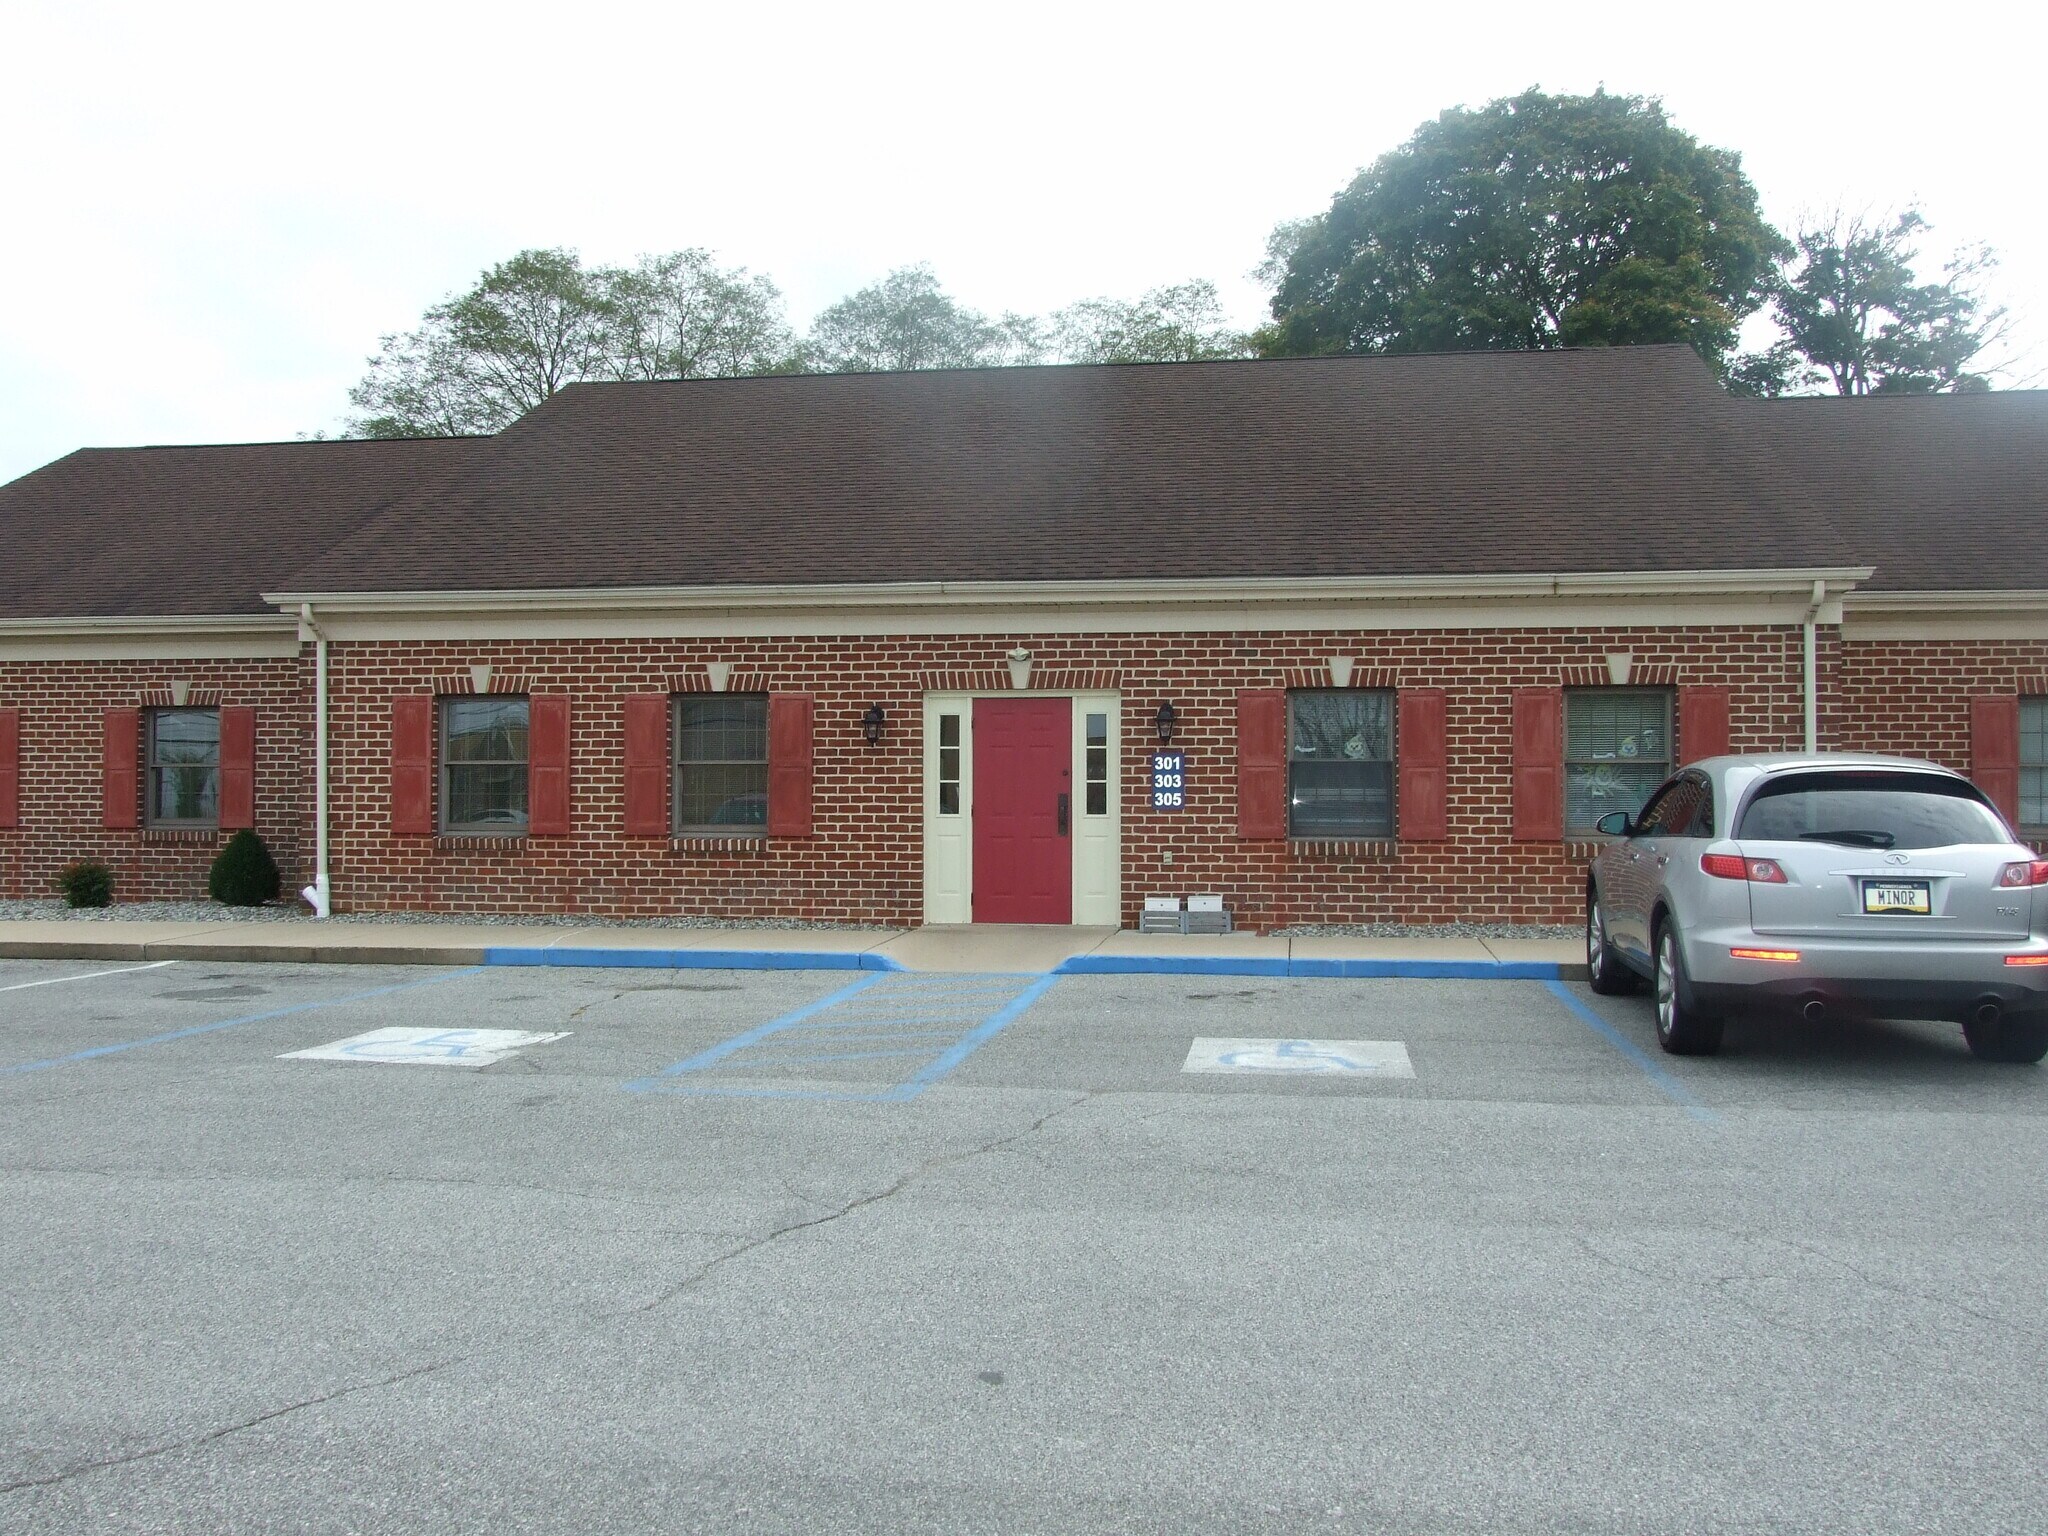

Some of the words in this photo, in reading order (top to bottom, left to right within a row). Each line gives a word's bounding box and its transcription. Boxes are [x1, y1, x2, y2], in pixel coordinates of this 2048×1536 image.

[1154, 756, 1180, 770] 301
[1154, 774, 1182, 788] 303
[1154, 792, 1182, 806] 305
[1877, 890, 1915, 905] MINOR
